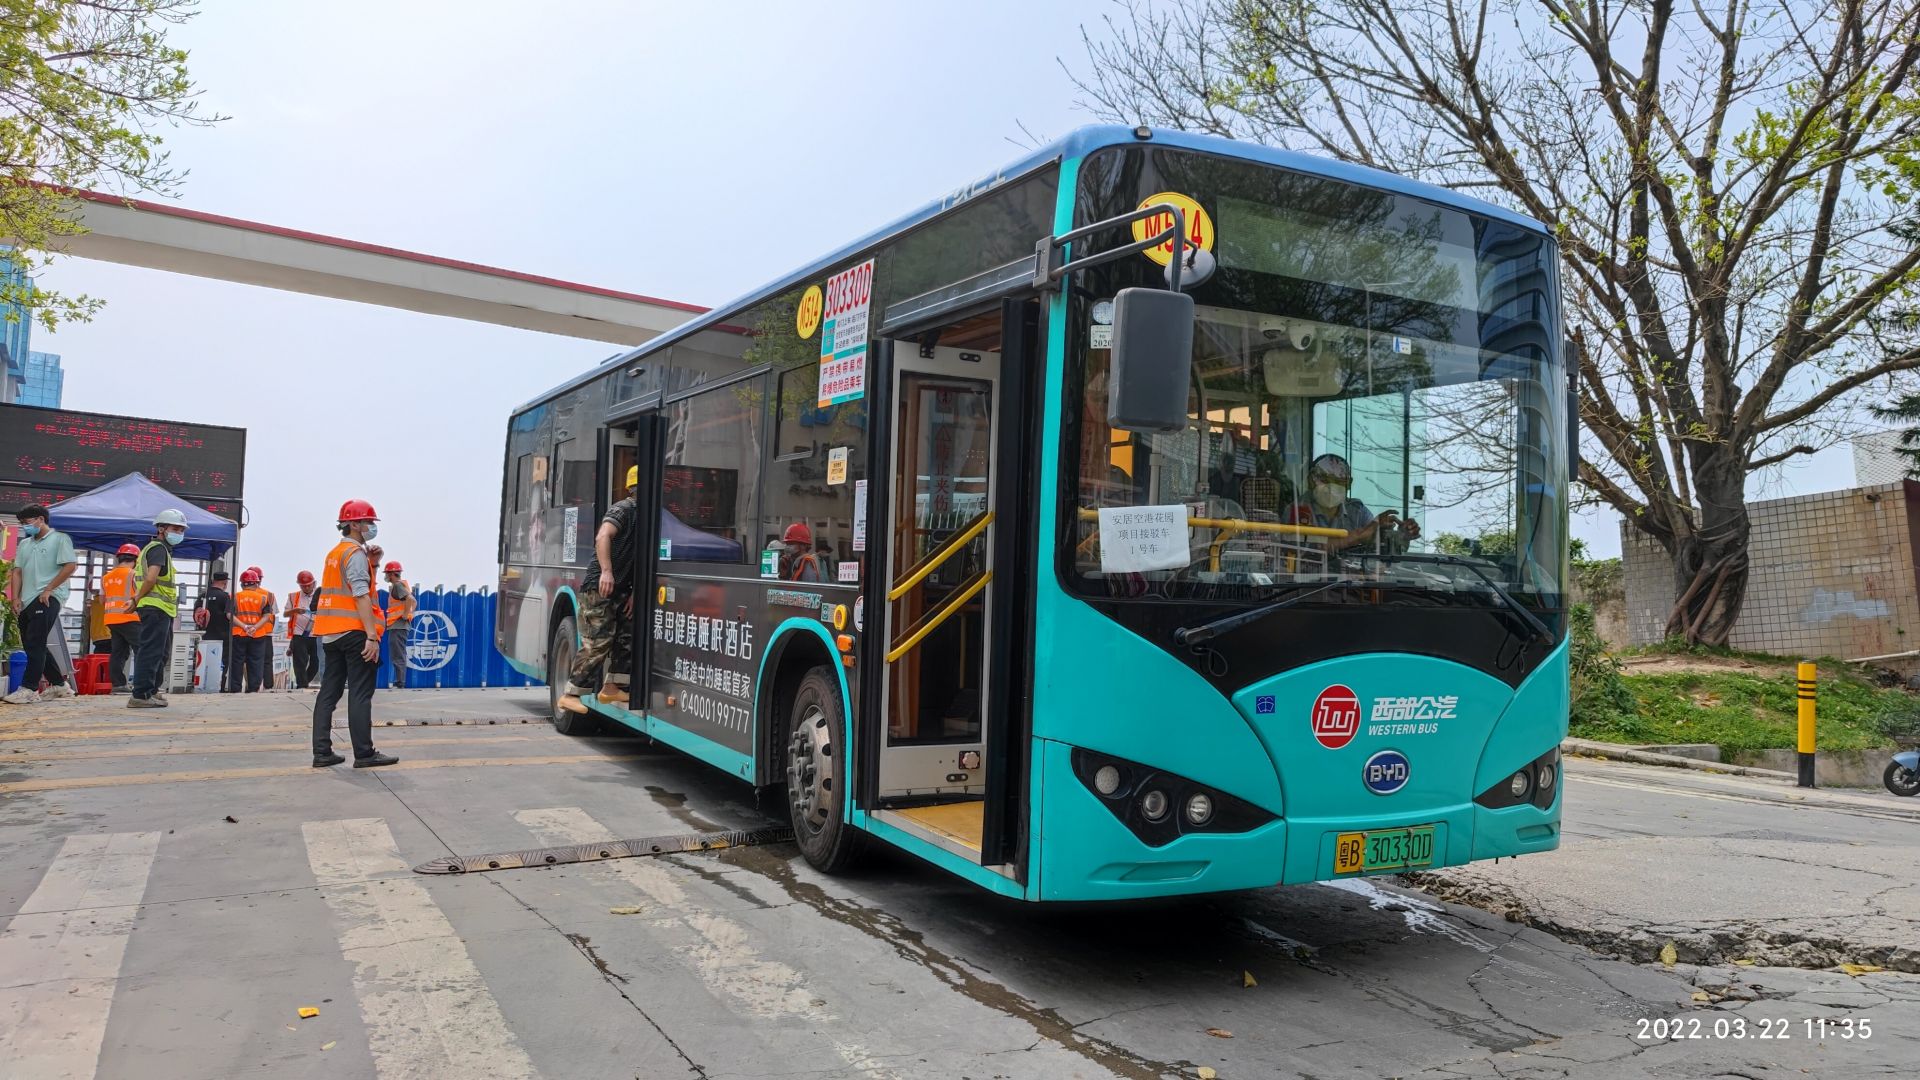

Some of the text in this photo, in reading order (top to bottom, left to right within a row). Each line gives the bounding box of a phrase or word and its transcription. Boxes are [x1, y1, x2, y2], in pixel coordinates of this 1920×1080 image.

[825, 263, 871, 319] 30330D
[799, 291, 820, 330] M514
[1112, 512, 1174, 526] 安居空港花园
[1118, 528, 1170, 541] 项目接驳车
[653, 609, 753, 661] 慕思健康睡眠酒店
[674, 657, 750, 698] 您旅途中的睡眠管家
[687, 694, 750, 734] 4000199777
[1371, 695, 1458, 721] 西部公汽
[1368, 723, 1438, 736] WESTERN BUS
[1370, 763, 1405, 782] BYD
[1340, 833, 1432, 868] 粤B 30330D
